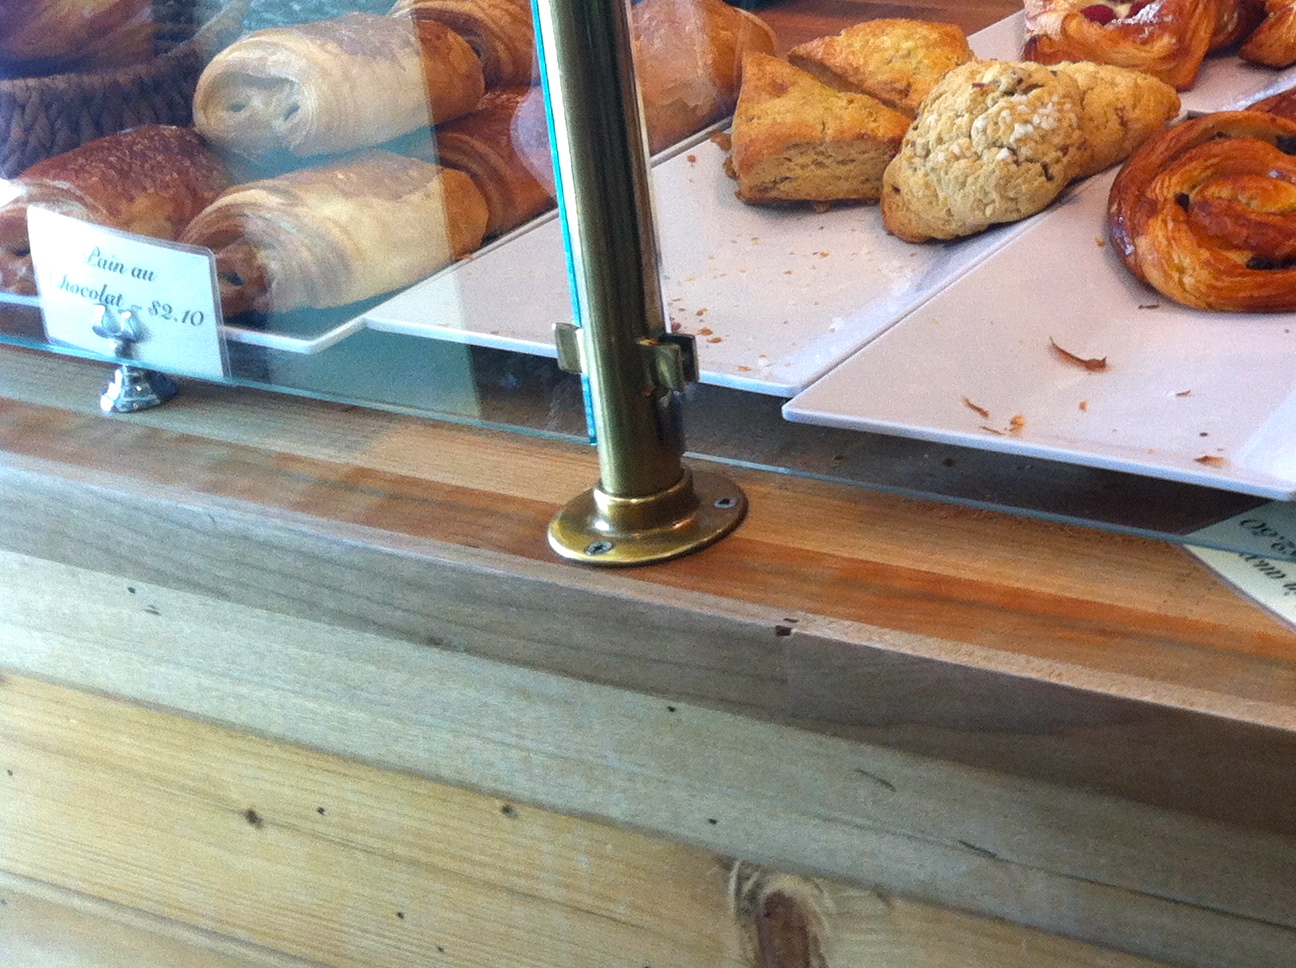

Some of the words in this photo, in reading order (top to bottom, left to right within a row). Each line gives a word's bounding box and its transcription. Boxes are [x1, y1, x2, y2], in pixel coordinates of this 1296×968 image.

[84, 246, 127, 275] Pain
[131, 265, 157, 283] au
[50, 273, 124, 308] hocolat
[147, 299, 205, 327] $2.10
